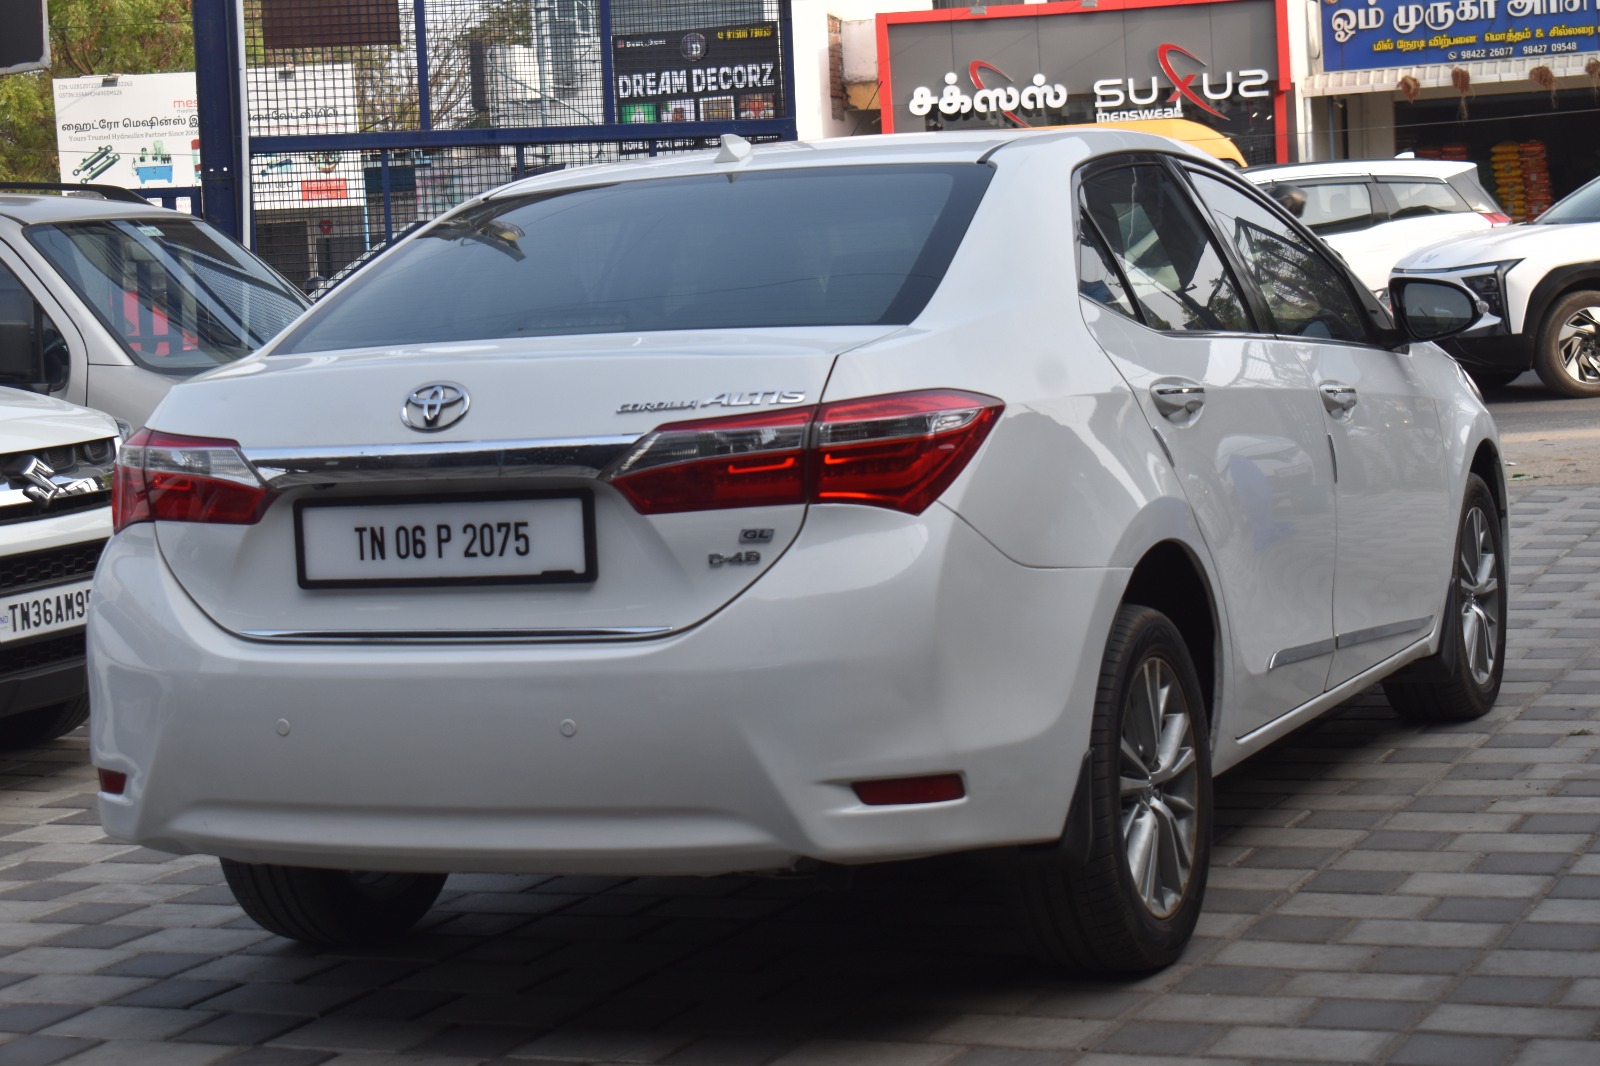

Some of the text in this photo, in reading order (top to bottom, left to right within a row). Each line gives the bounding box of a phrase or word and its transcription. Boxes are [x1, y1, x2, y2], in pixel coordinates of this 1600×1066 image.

[1373, 38, 1394, 51] மில்
[1397, 39, 1425, 51] நேரடி
[1428, 34, 1477, 48] விற்பனை
[1485, 27, 1532, 42] மொத்தம்
[1535, 28, 1544, 38] &
[1549, 24, 1595, 38] சில்லரை
[1461, 49, 1486, 59] 98422
[1523, 44, 1547, 54] 98427
[1551, 42, 1577, 52] 09548
[618, 61, 775, 99] DREAM DECORZ
[909, 72, 1067, 116] சக்ஸஸ்
[616, 390, 807, 415] COROLLA ALTIS
[354, 521, 531, 561] TN 06 P 2075
